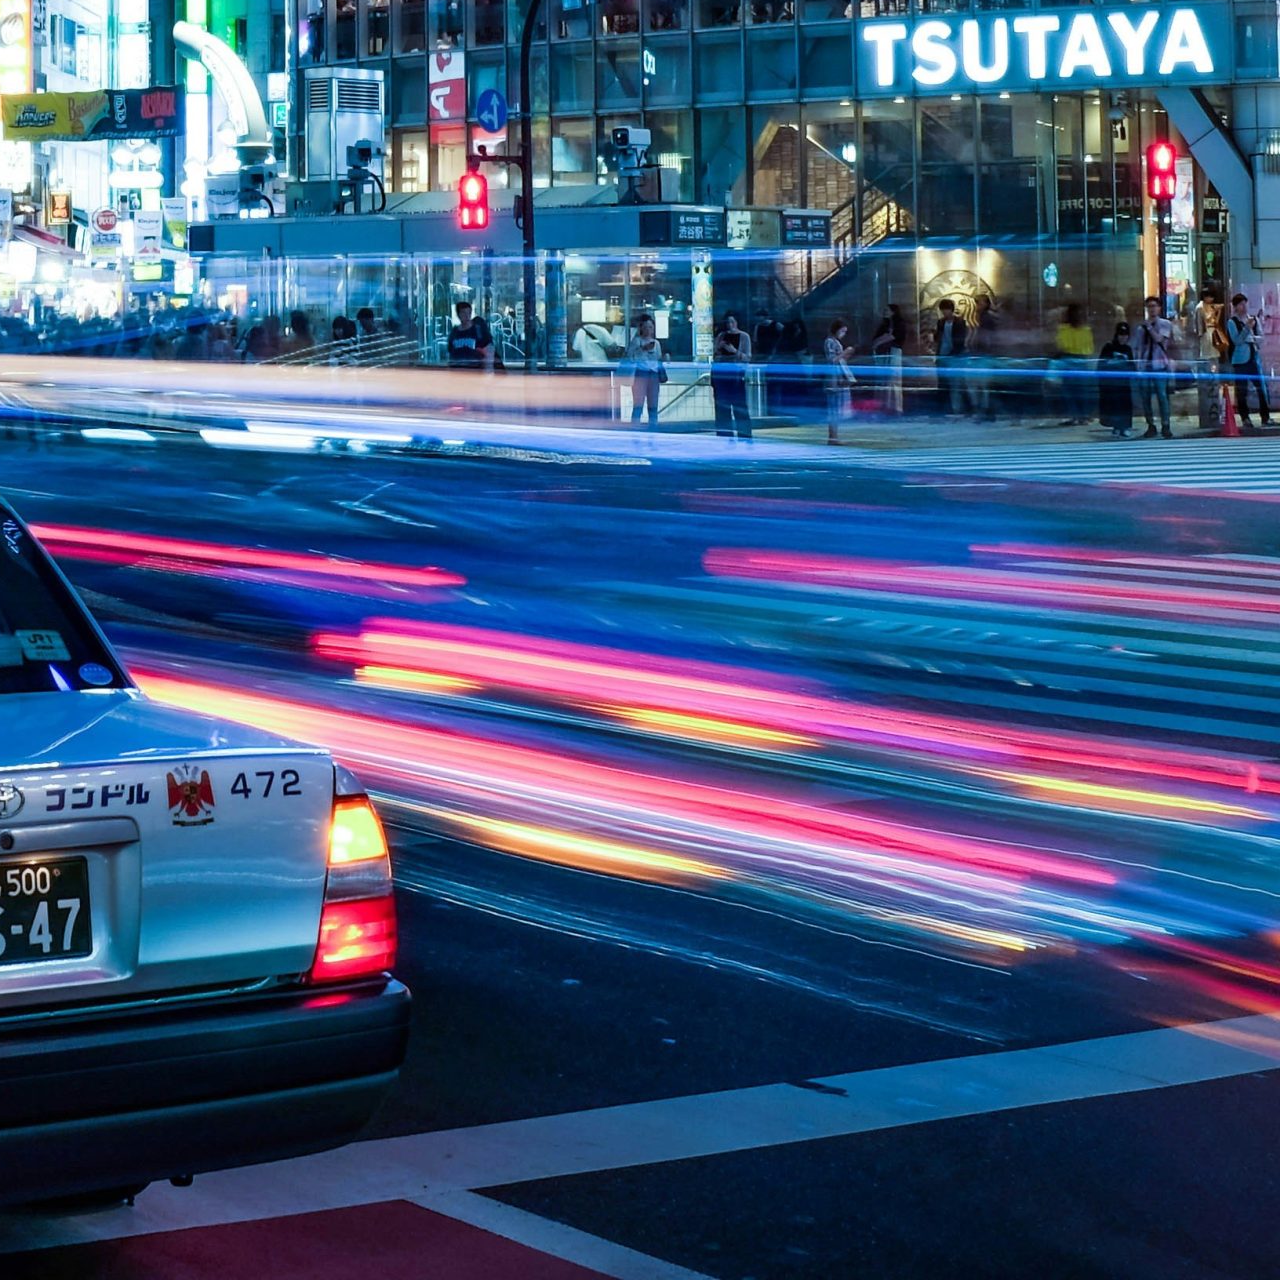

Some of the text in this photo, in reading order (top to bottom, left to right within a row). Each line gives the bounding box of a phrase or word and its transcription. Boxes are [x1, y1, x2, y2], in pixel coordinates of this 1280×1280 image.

[863, 9, 1216, 87] TSUTAYA
[46, 770, 302, 812] コンドル 472
[8, 867, 51, 897] 500
